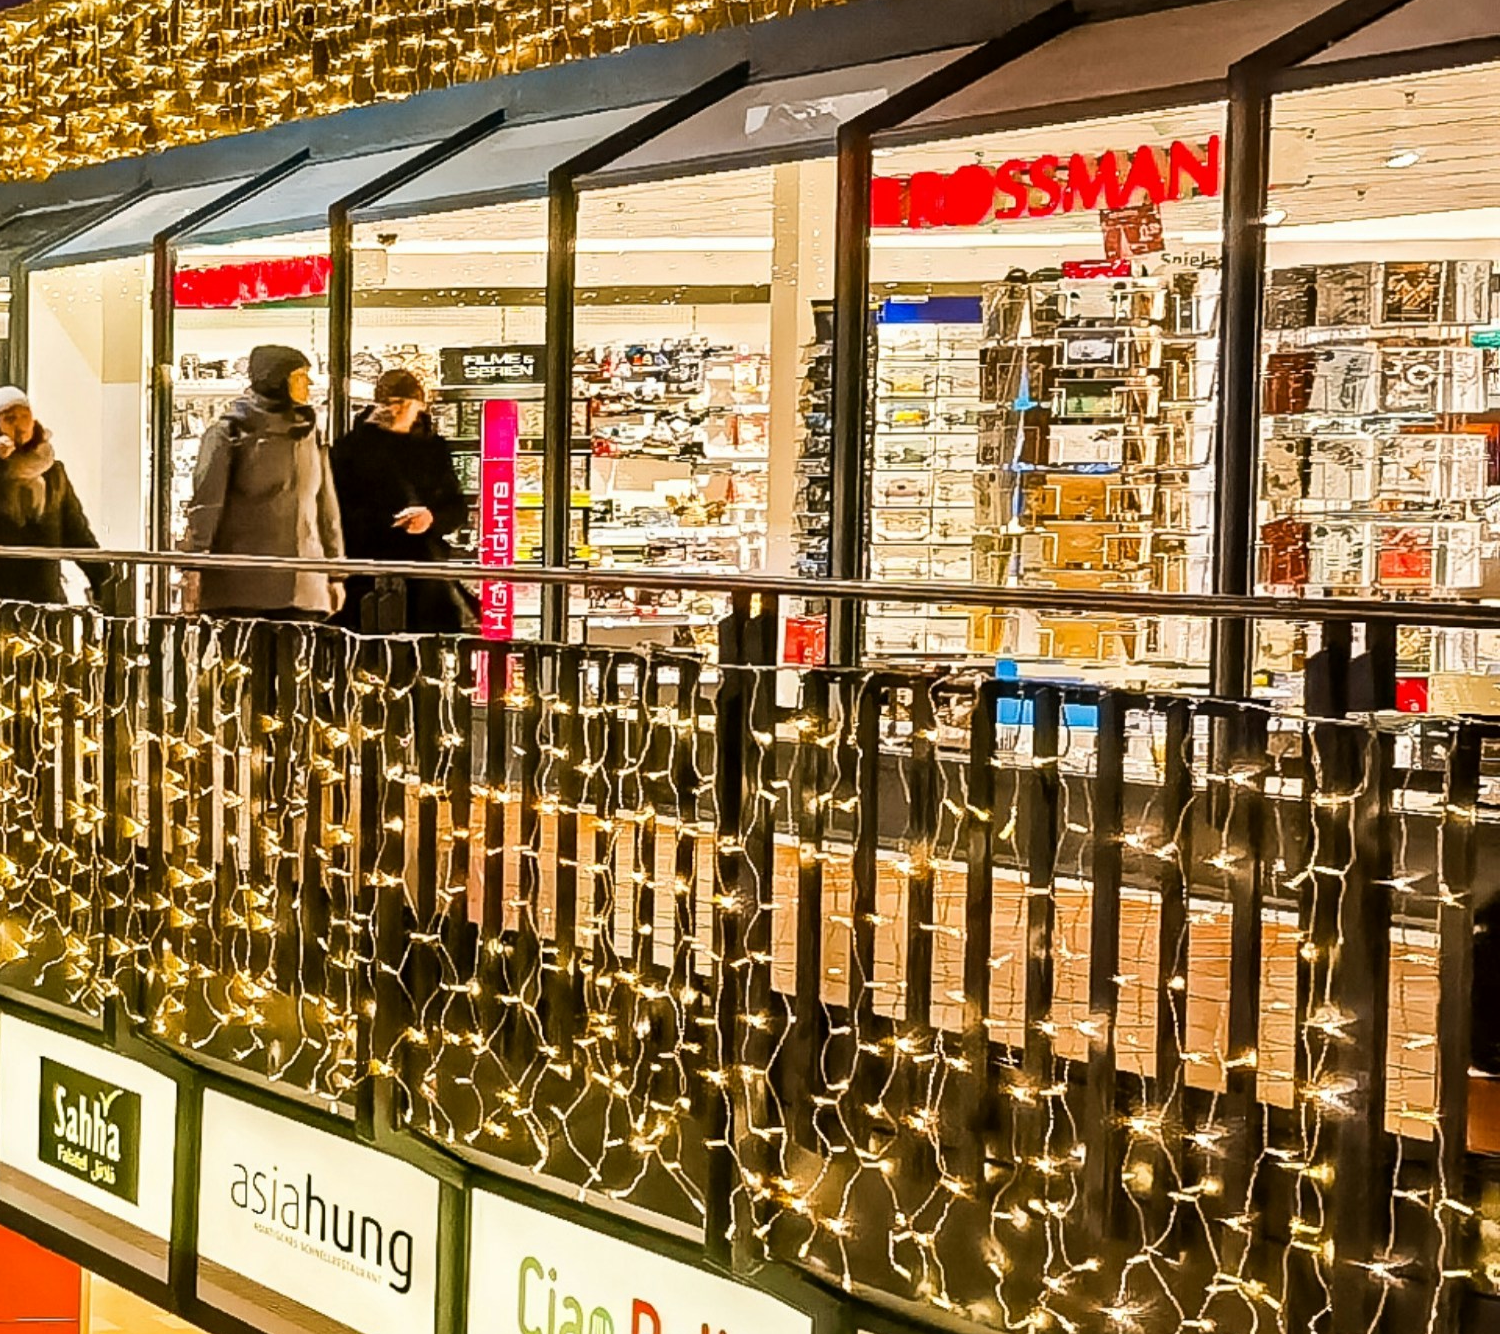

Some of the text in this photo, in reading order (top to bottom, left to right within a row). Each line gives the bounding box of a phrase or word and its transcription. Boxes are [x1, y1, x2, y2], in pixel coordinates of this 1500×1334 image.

[462, 352, 521, 366] FILME
[463, 365, 534, 379] SERIEN
[53, 1083, 121, 1163] Sahha
[230, 1162, 414, 1295] asiahung
